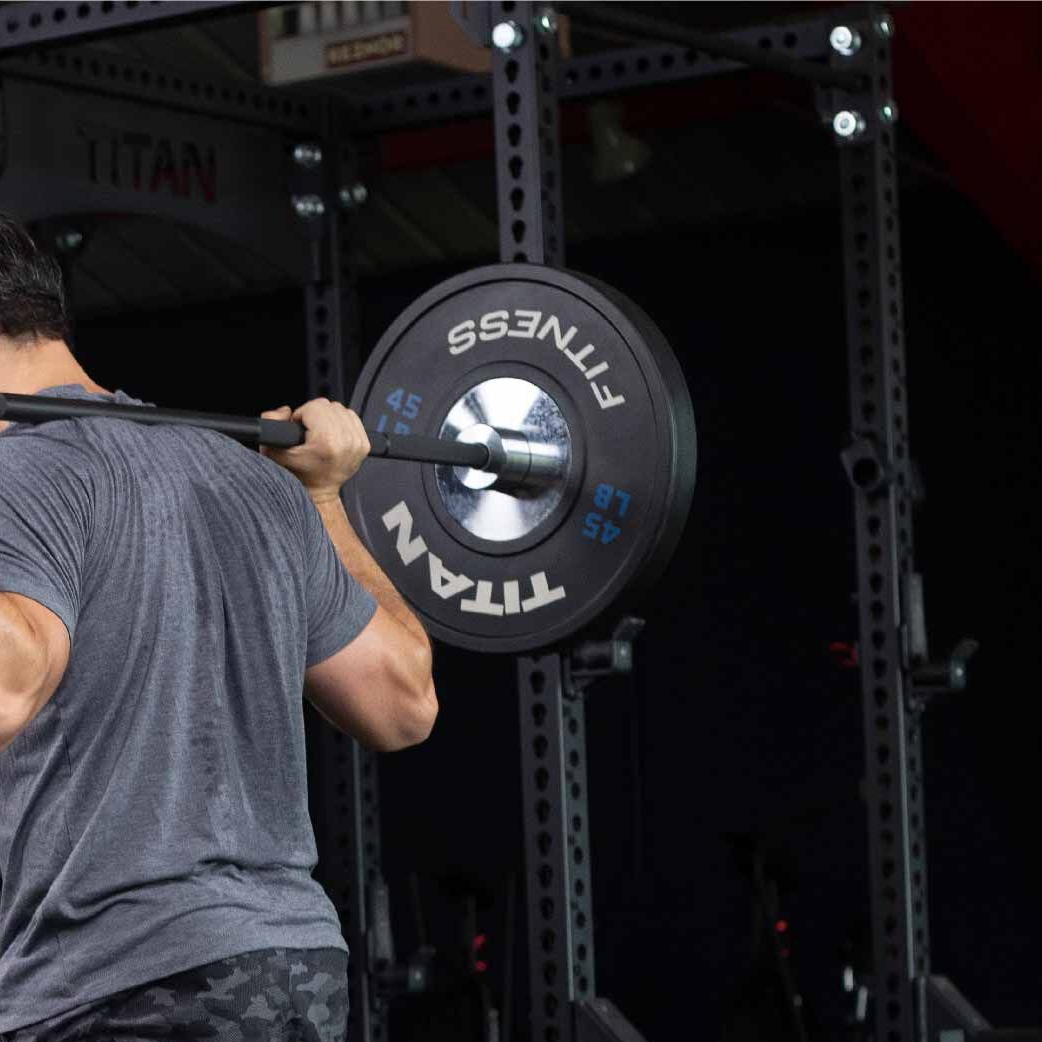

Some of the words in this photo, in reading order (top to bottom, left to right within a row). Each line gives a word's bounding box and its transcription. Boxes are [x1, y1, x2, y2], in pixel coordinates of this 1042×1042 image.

[446, 309, 626, 411] FITNESS
[386, 388, 423, 420] 45
[594, 482, 631, 518] LB
[582, 513, 622, 546] 45
[381, 500, 566, 616] TITAN
